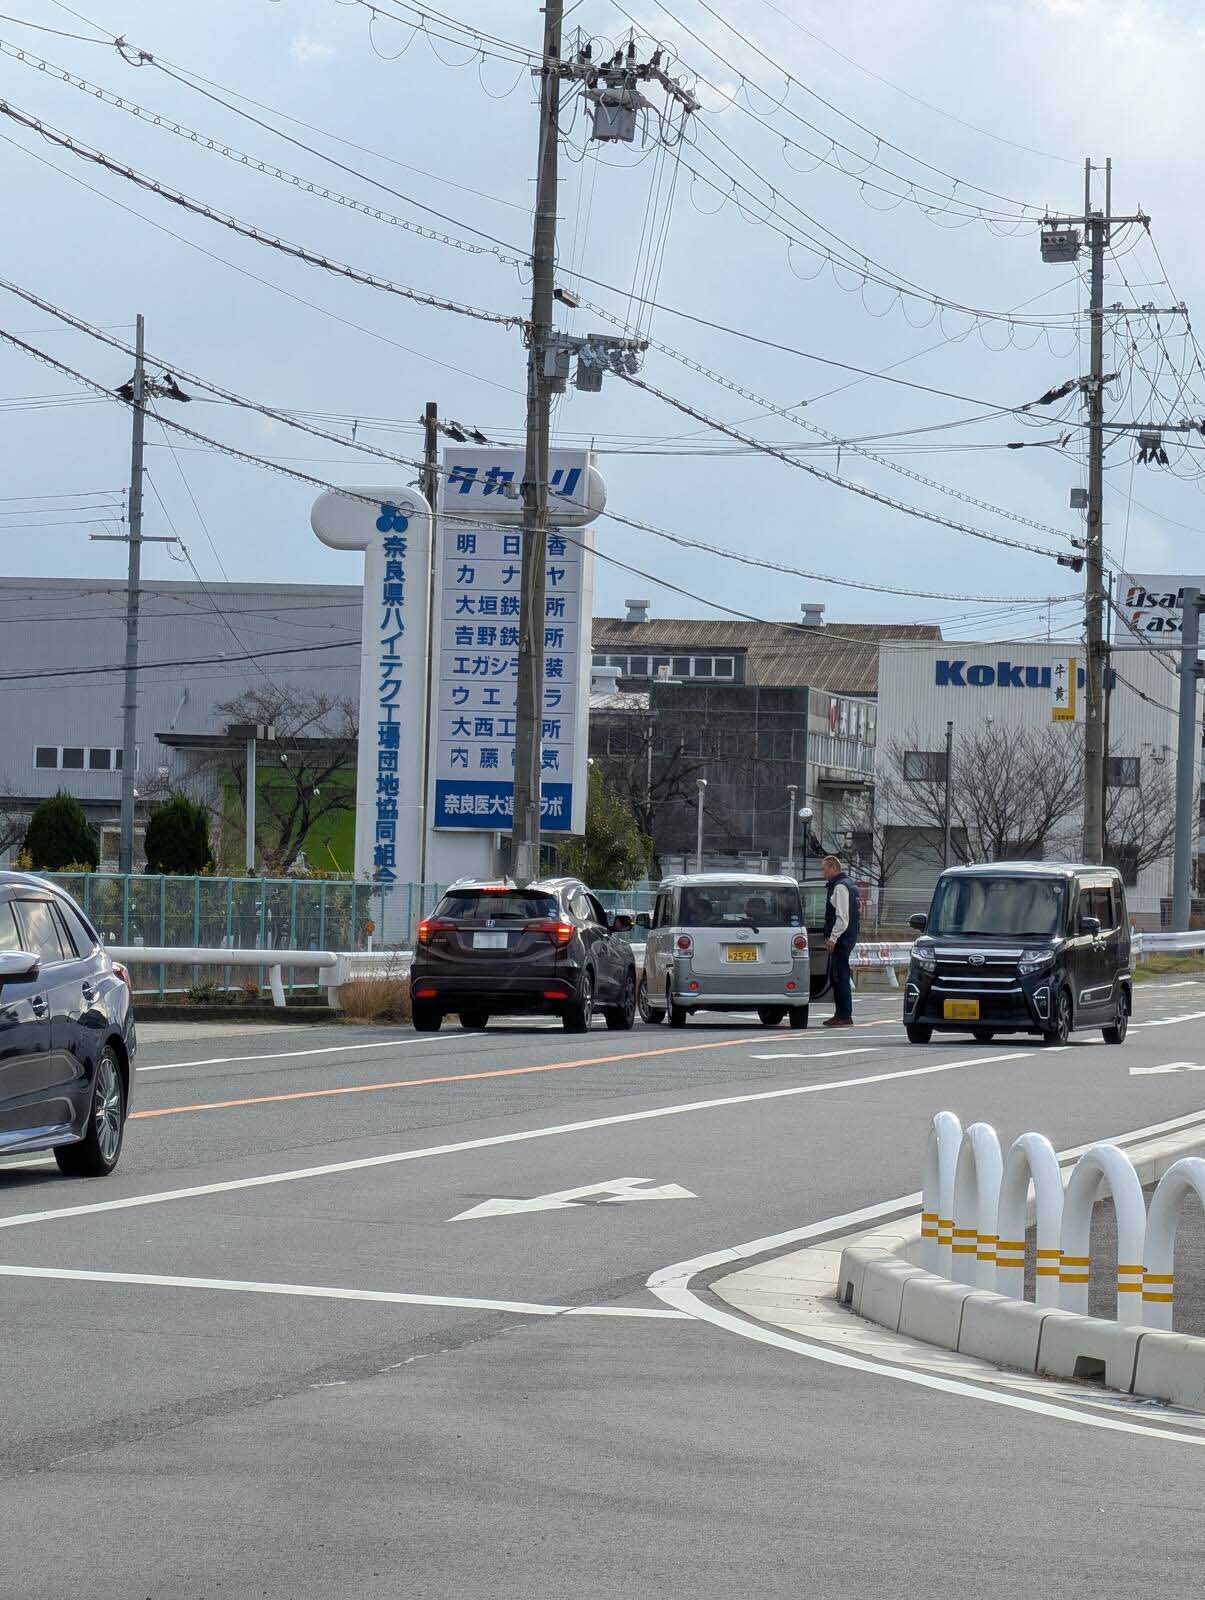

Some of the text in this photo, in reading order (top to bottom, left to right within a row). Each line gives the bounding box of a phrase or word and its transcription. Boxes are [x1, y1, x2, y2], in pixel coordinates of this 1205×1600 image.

[447, 465, 582, 497] タカリ
[456, 534, 567, 556] 明日香
[456, 564, 566, 586] カナヤ
[455, 594, 566, 618] 大垣鉄所
[454, 625, 565, 648] 吉野鉄所
[452, 656, 564, 678] エガシラ装
[451, 686, 562, 708] ウエラ
[451, 716, 562, 740] 大西工所
